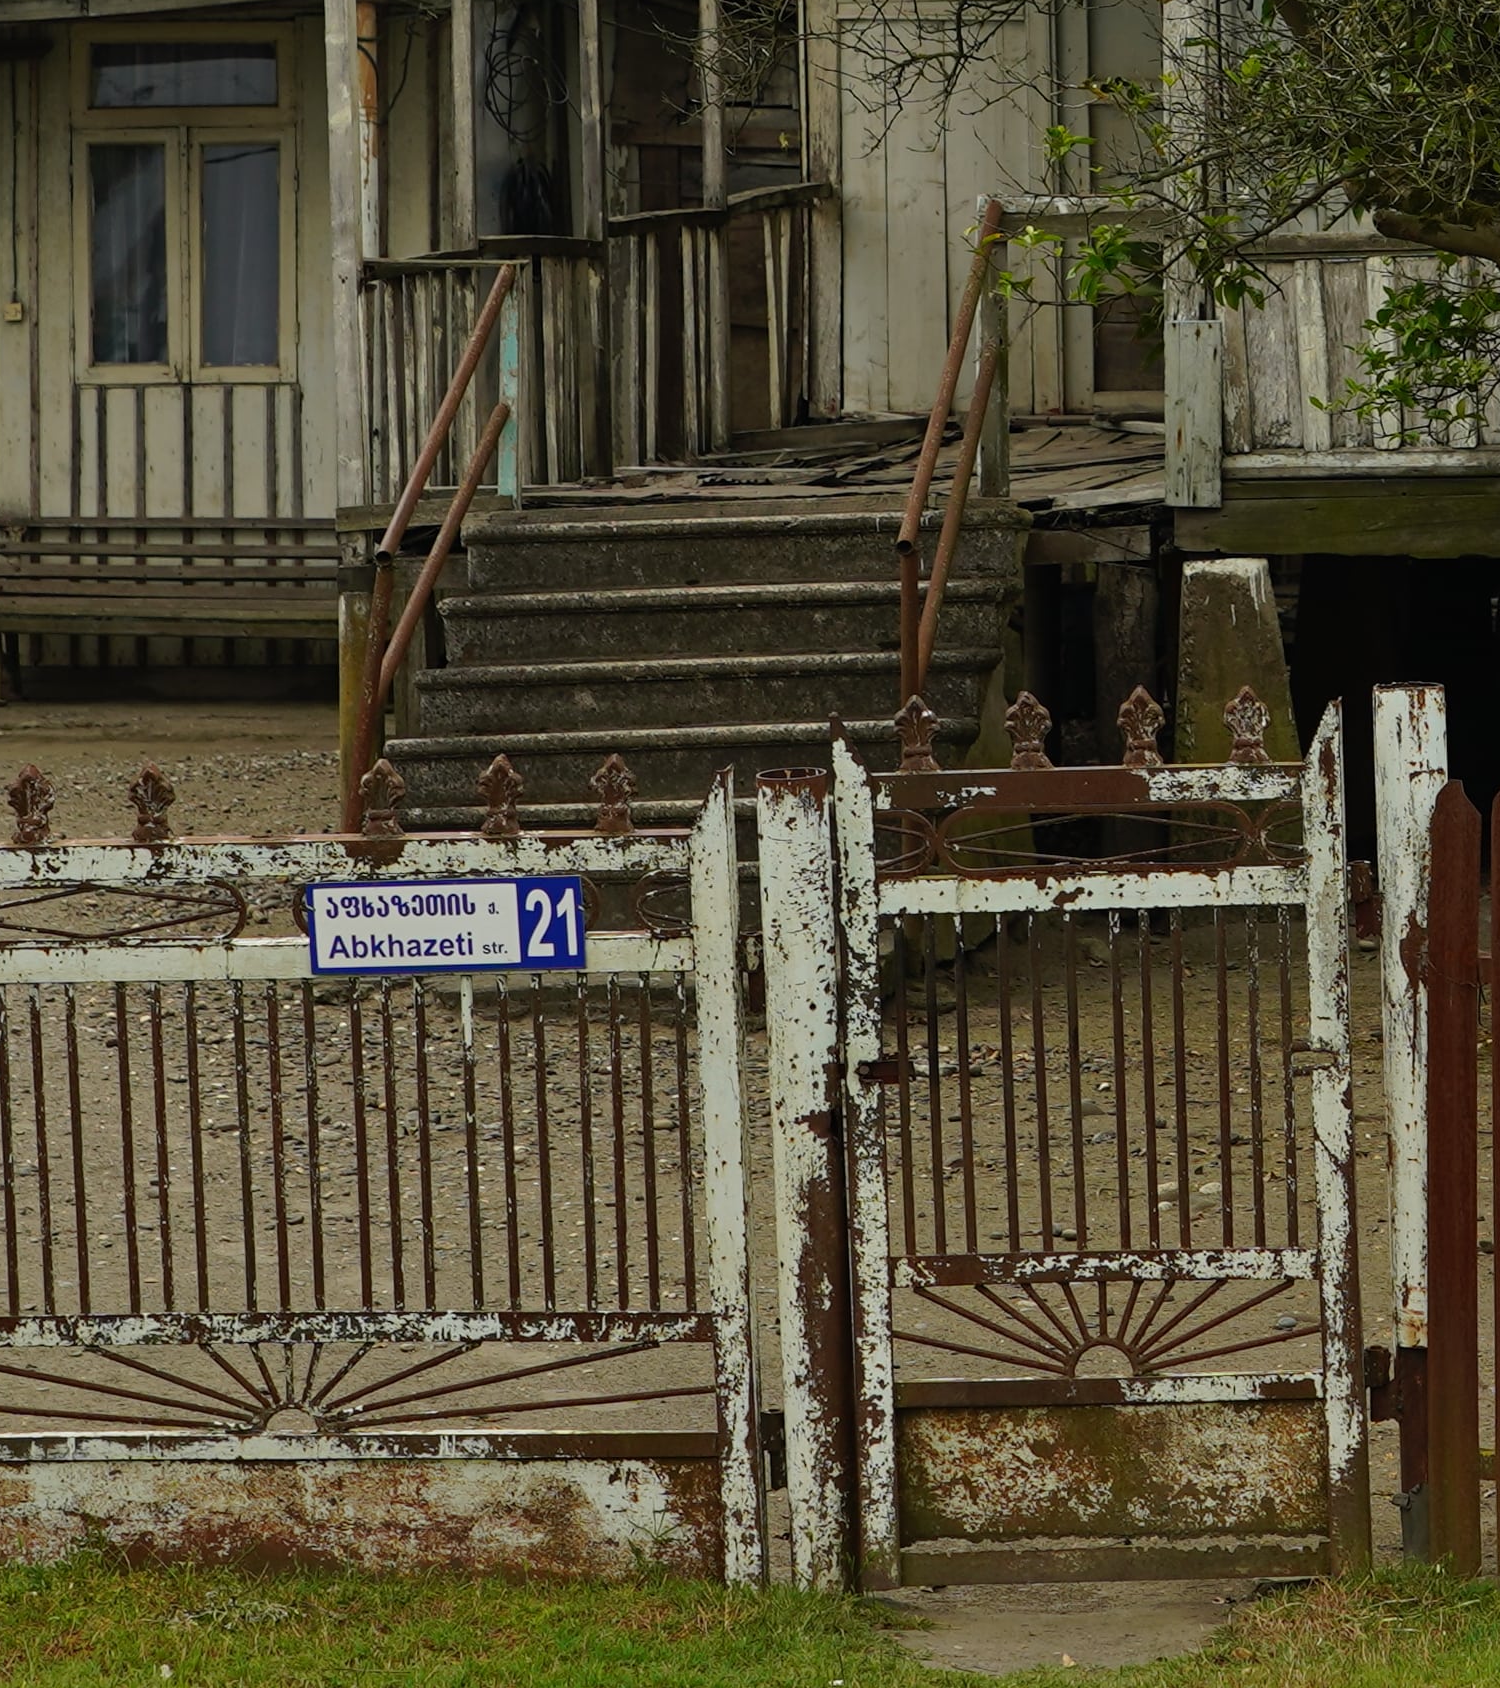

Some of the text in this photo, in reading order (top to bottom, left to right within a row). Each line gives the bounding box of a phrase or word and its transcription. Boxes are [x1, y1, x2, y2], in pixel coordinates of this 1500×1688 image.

[326, 892, 476, 919] აფხაზეთის
[525, 887, 578, 958] 21
[329, 932, 508, 959] Abkhazeti str.
